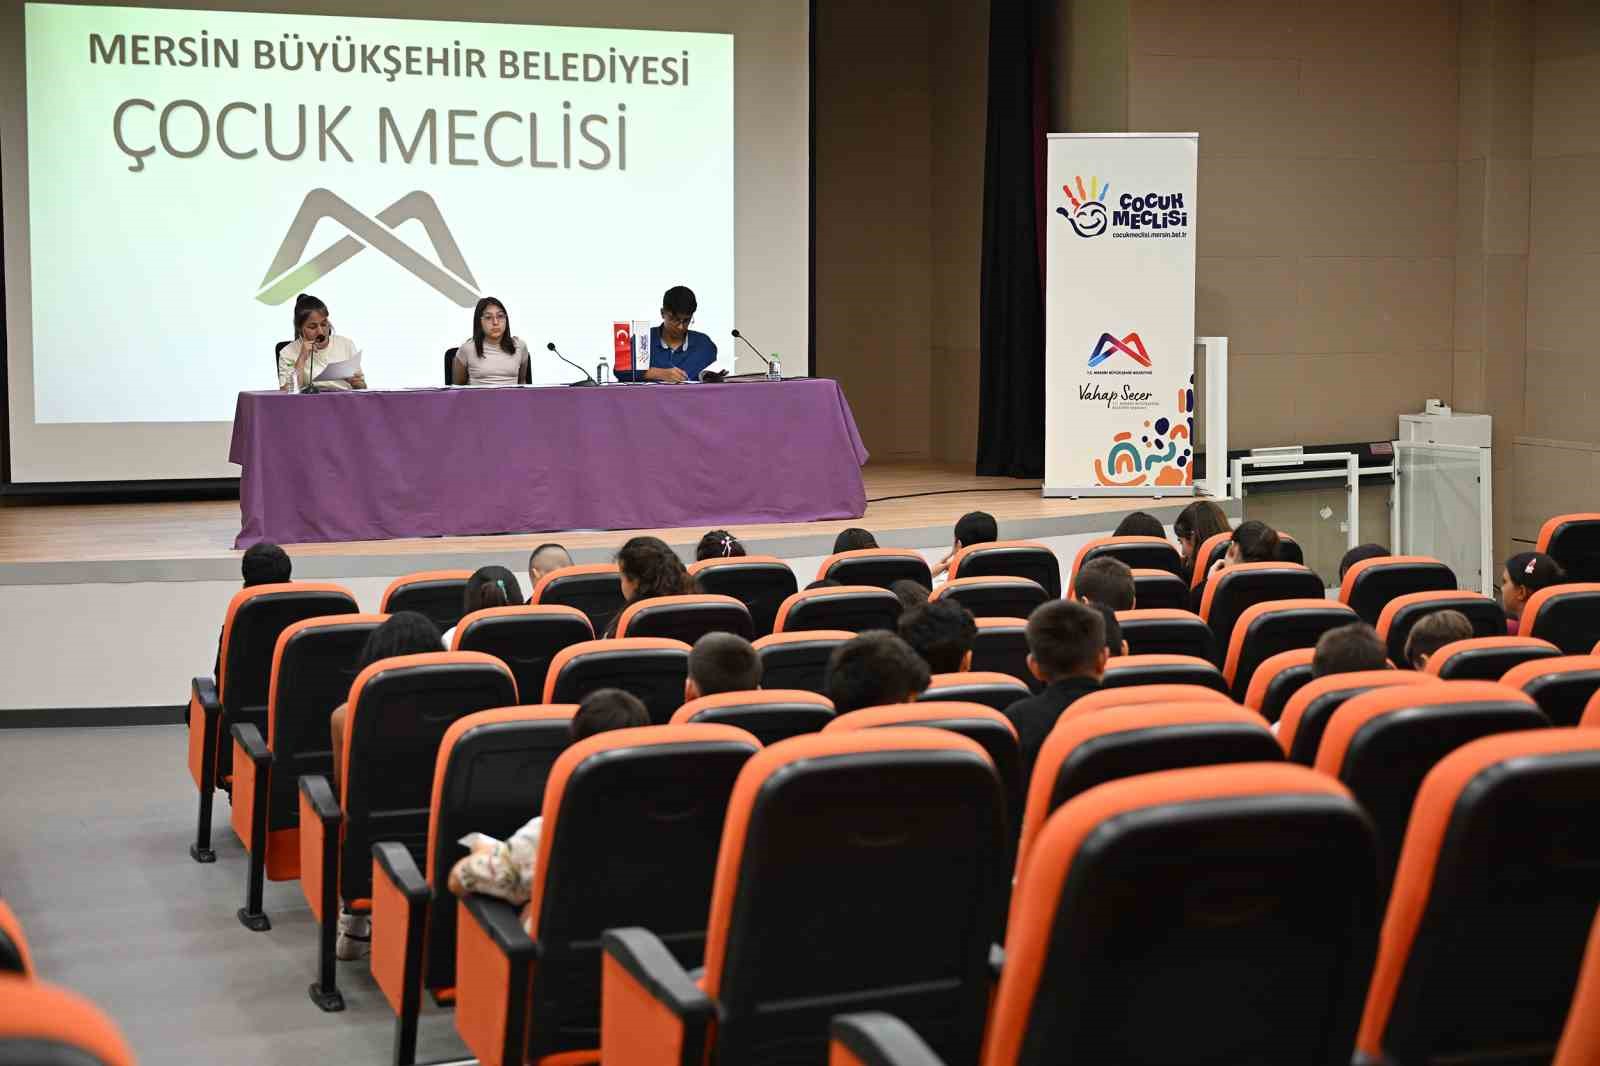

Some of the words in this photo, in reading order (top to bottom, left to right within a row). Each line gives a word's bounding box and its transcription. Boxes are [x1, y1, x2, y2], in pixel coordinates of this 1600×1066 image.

[88, 31, 240, 69] MERSİN
[253, 34, 487, 82] BÜYÜKŞEHİR
[499, 48, 691, 87] BELEDİYESİ
[112, 98, 354, 172] ÇOCUK
[378, 101, 628, 171] MECLİSİ
[1079, 383, 1118, 408] Vahap
